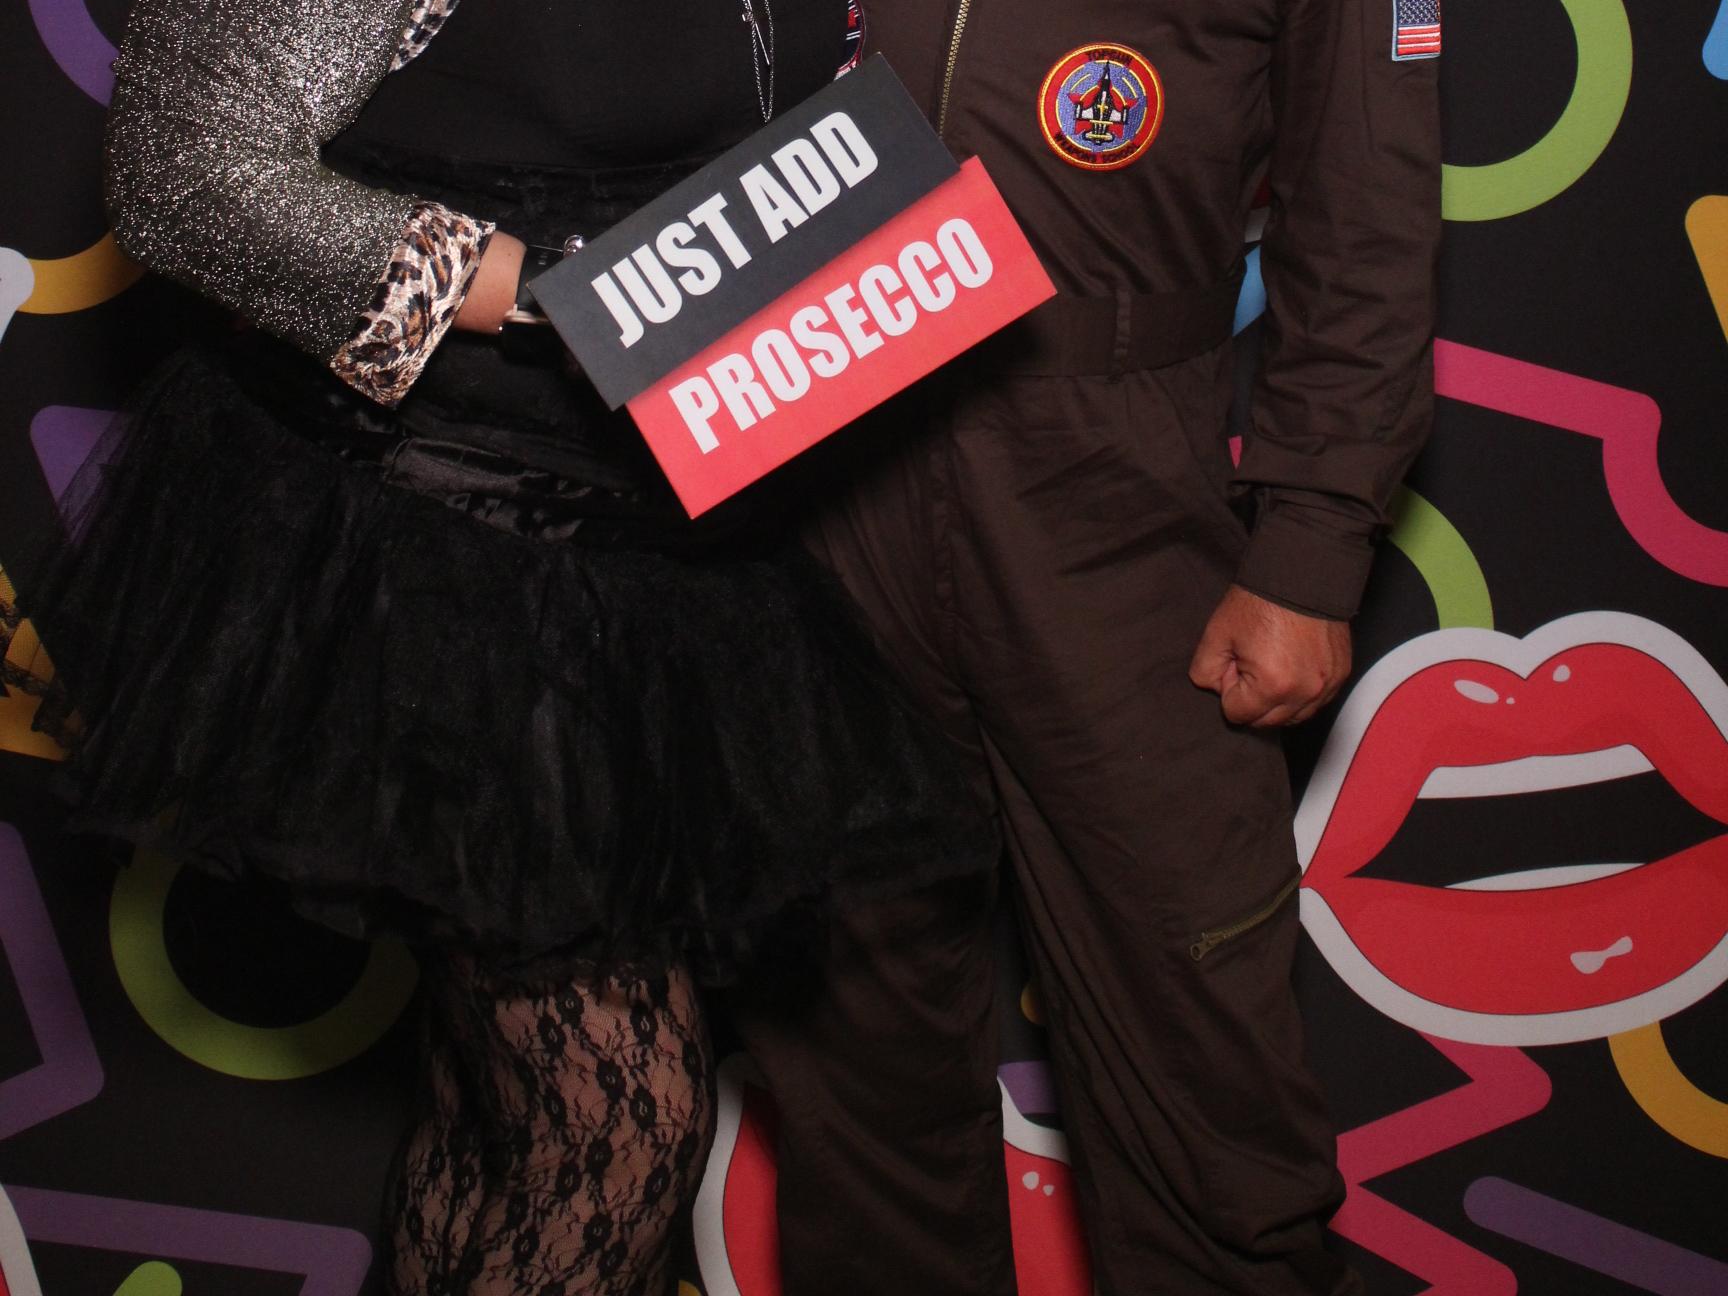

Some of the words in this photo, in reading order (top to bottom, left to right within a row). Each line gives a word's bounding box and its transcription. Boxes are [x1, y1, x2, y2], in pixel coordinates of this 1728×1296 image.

[590, 192, 753, 349] JUST
[738, 110, 879, 244] ADD
[668, 217, 995, 455] PROSECCO
